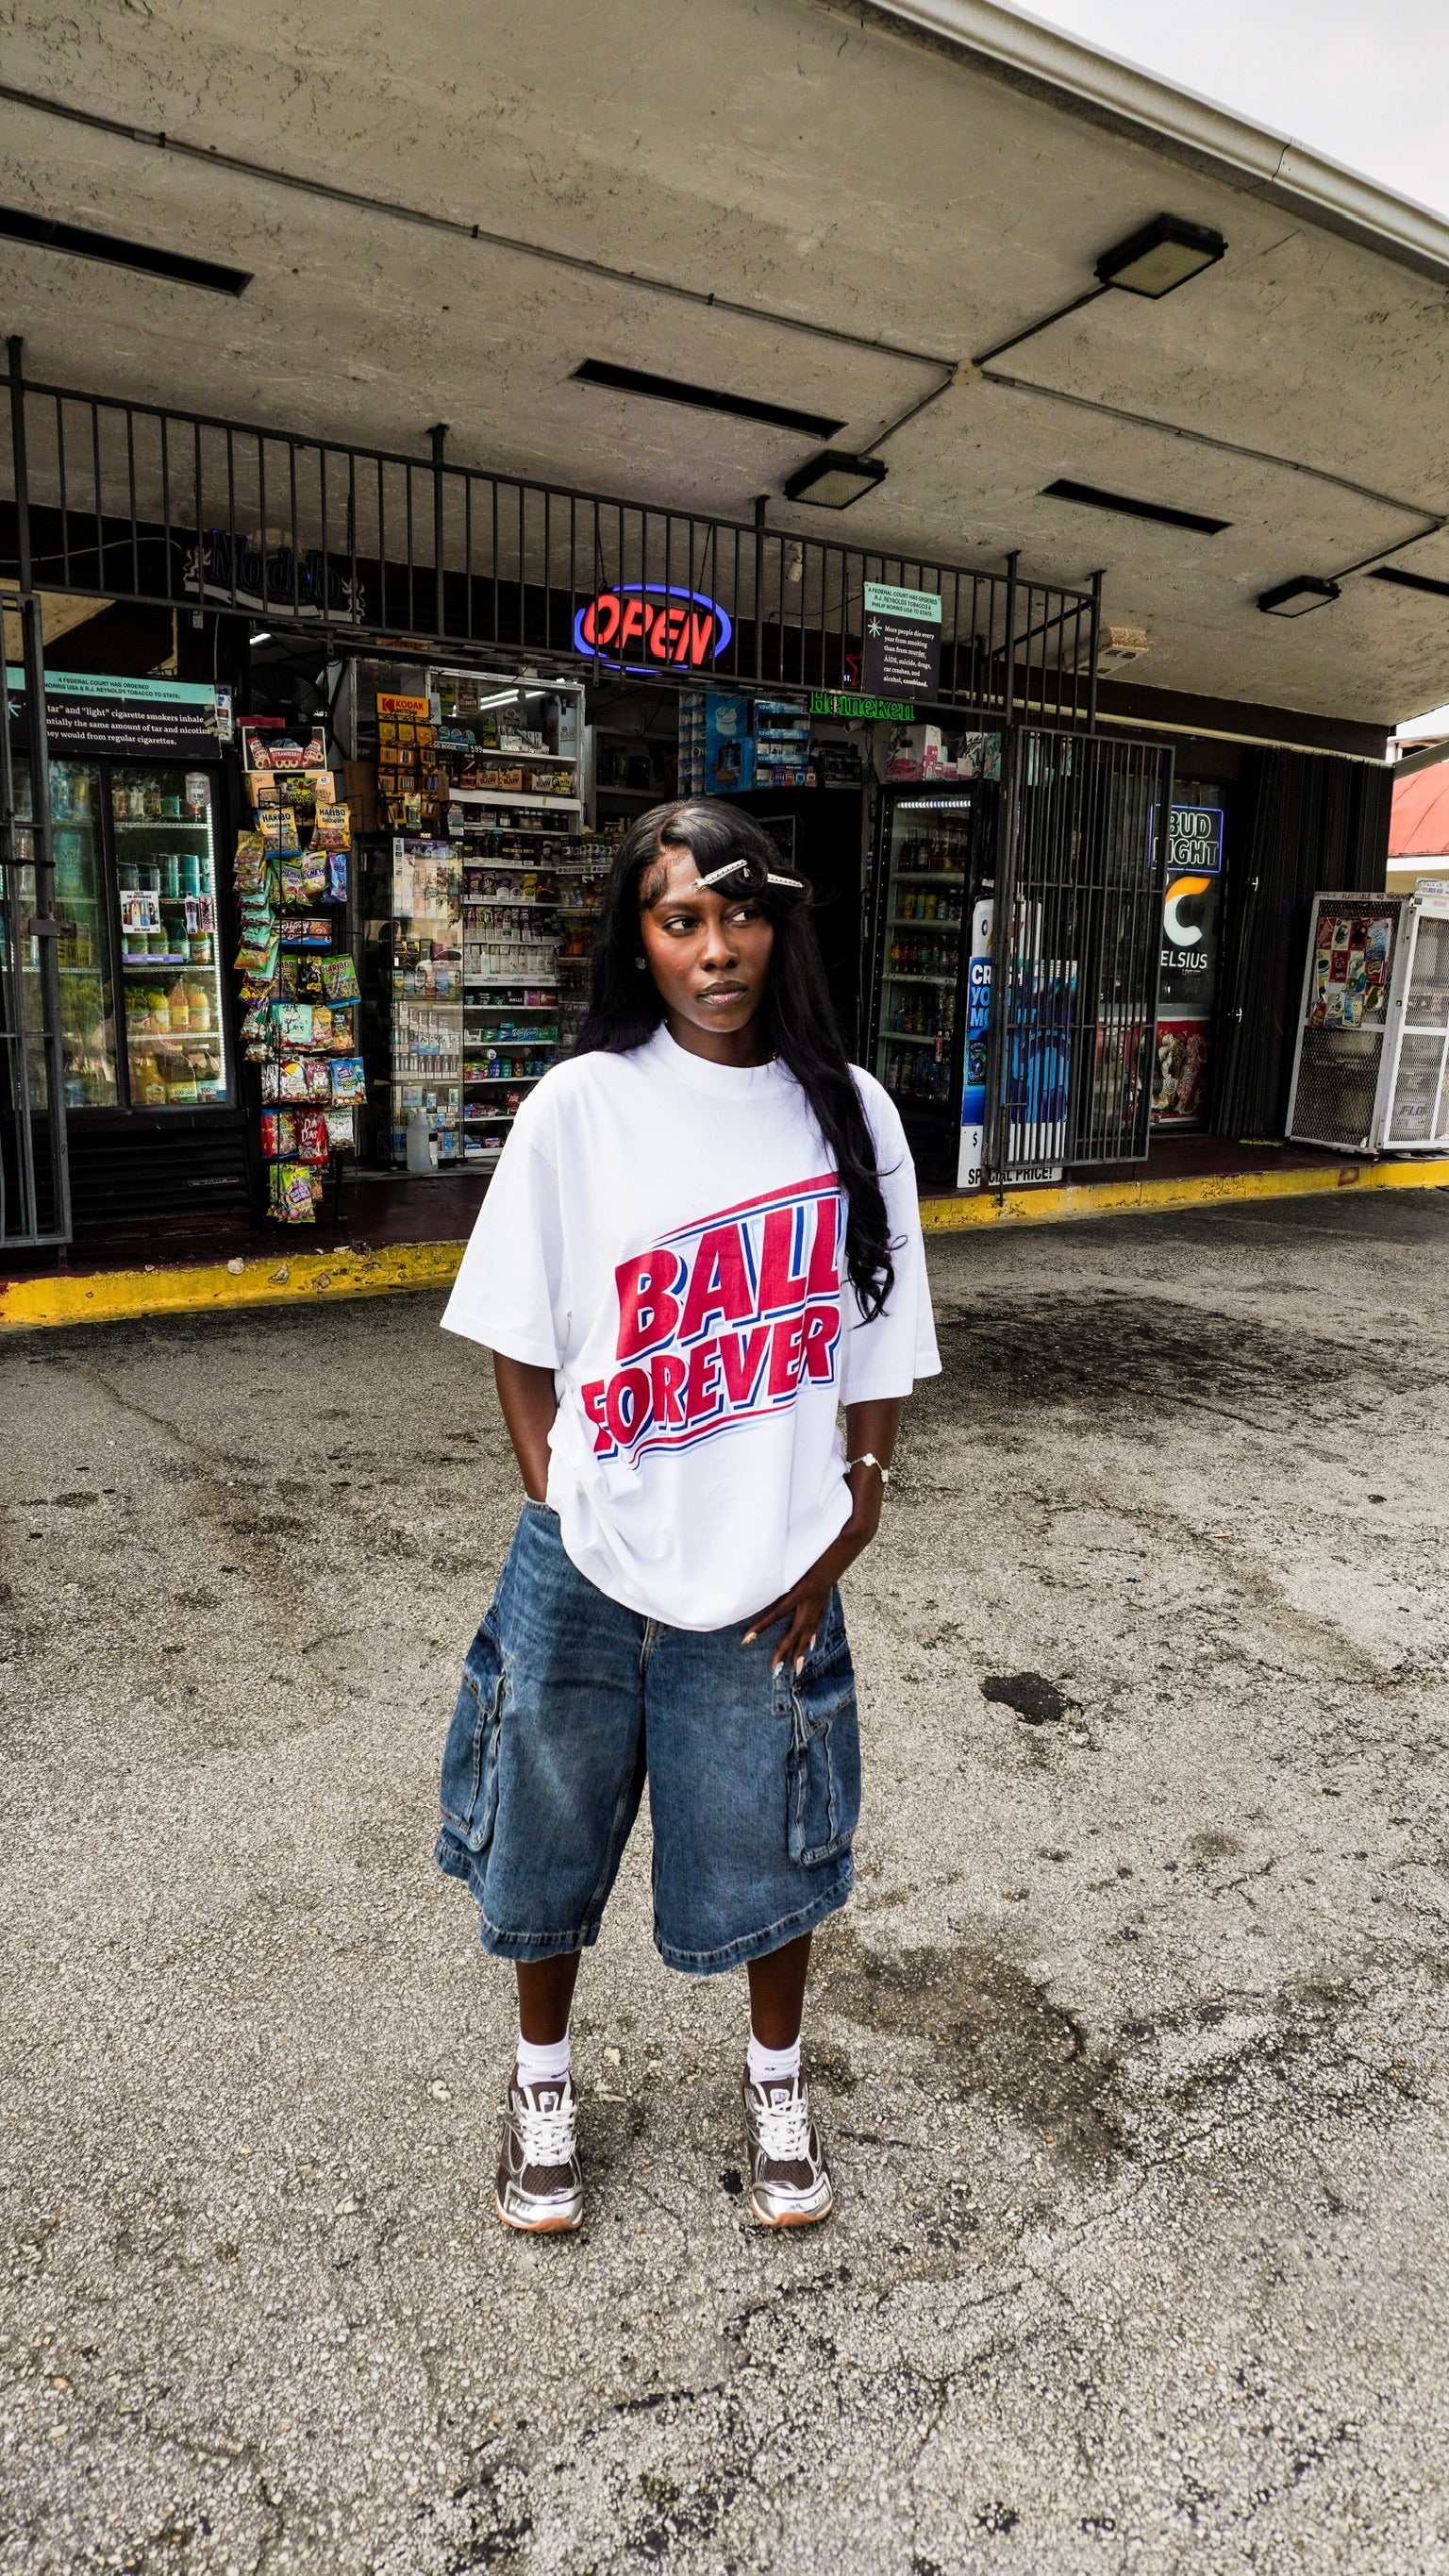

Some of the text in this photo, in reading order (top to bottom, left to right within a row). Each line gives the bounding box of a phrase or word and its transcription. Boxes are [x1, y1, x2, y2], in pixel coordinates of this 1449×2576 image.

[209, 528, 341, 604] Modelo
[873, 588, 892, 596] FEDERAL
[919, 596, 938, 605] ORDERED
[884, 596, 907, 605] REYNOLDS
[908, 601, 927, 610] TOBACCO
[583, 594, 713, 665] OPEN
[898, 628, 913, 637] people
[895, 636, 907, 644] from
[908, 640, 928, 649] smoking
[883, 656, 899, 664] AIDS,
[395, 700, 425, 711] KODAK
[809, 692, 916, 722] Heineken
[111, 710, 145, 720] cigarette
[179, 714, 205, 723] inhale
[108, 734, 136, 744] regular
[137, 736, 177, 744] cigarettes.
[261, 812, 291, 822] HARIBO
[1169, 811, 1211, 839] BUD
[322, 961, 350, 973] HARIBO
[1160, 950, 1208, 969] ELSIUS
[968, 1167, 1053, 1185] SPCIAL PRICE!
[615, 1196, 842, 1367] BALL
[580, 1305, 842, 1461] FOREVER
